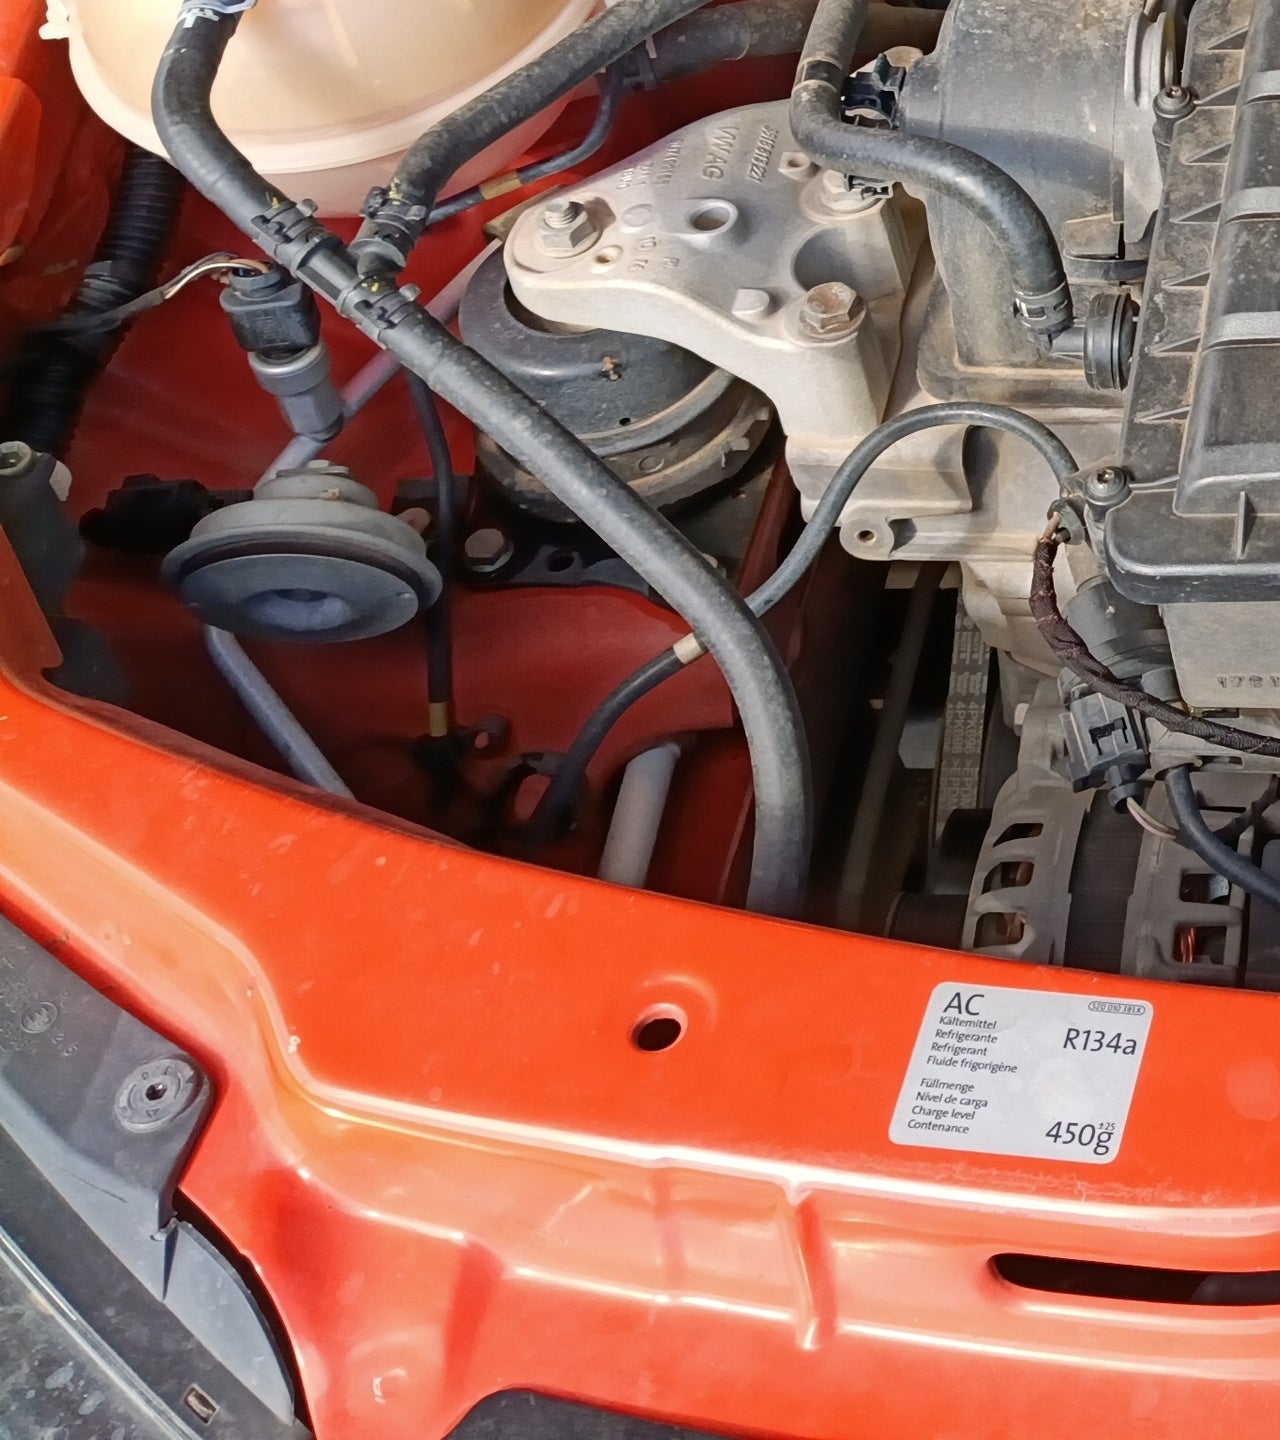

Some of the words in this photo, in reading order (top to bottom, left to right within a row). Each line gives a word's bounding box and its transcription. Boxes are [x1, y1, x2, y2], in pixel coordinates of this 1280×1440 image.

[943, 992, 984, 1016] AC
[939, 1016, 997, 1030] Kältemittel
[935, 1028, 997, 1044] Refrigerante
[1062, 1028, 1137, 1055] R134a
[930, 1042, 987, 1056] Refrigerant
[926, 1055, 959, 1067] Fluide
[960, 1058, 1018, 1073] frigorigène
[920, 1077, 974, 1093] Füllmenge
[915, 1091, 942, 1103] Nível
[943, 1094, 957, 1104] de
[959, 1097, 988, 1108] carga
[911, 1105, 949, 1119] Charge
[950, 1109, 975, 1120] level
[907, 1119, 970, 1134] Contenance
[1045, 1121, 1113, 1155] 450g
